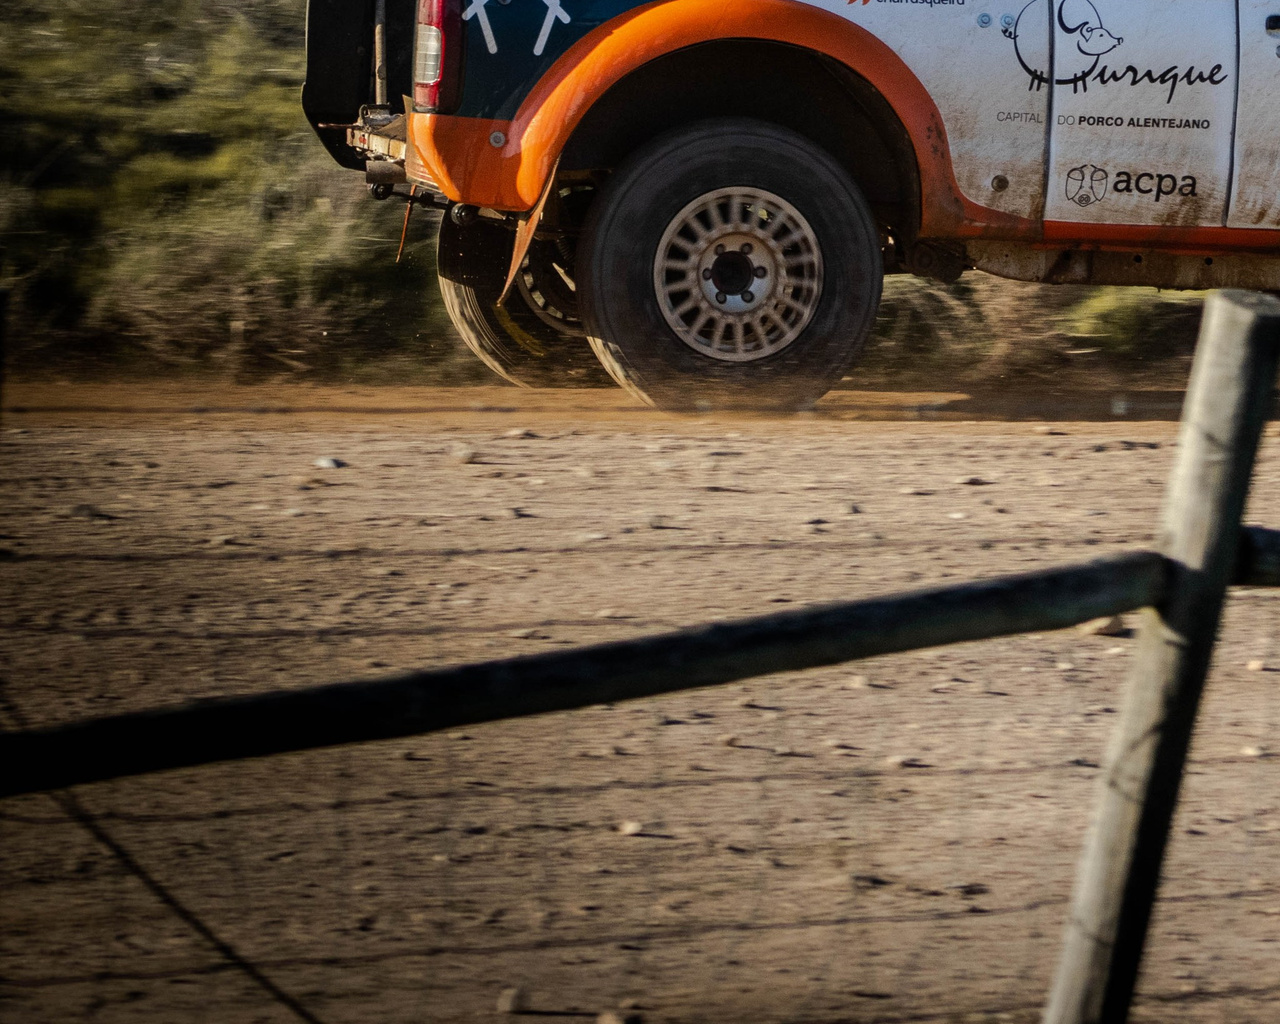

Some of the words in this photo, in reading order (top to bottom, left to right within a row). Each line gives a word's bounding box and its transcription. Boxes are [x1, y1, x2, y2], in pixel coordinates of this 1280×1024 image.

[996, 112, 1043, 124] CAPITAL
[1057, 115, 1075, 125] DO
[1078, 115, 1124, 127] PORCO
[1127, 117, 1211, 129] ALENTEJANO
[1112, 170, 1198, 202] acpa
